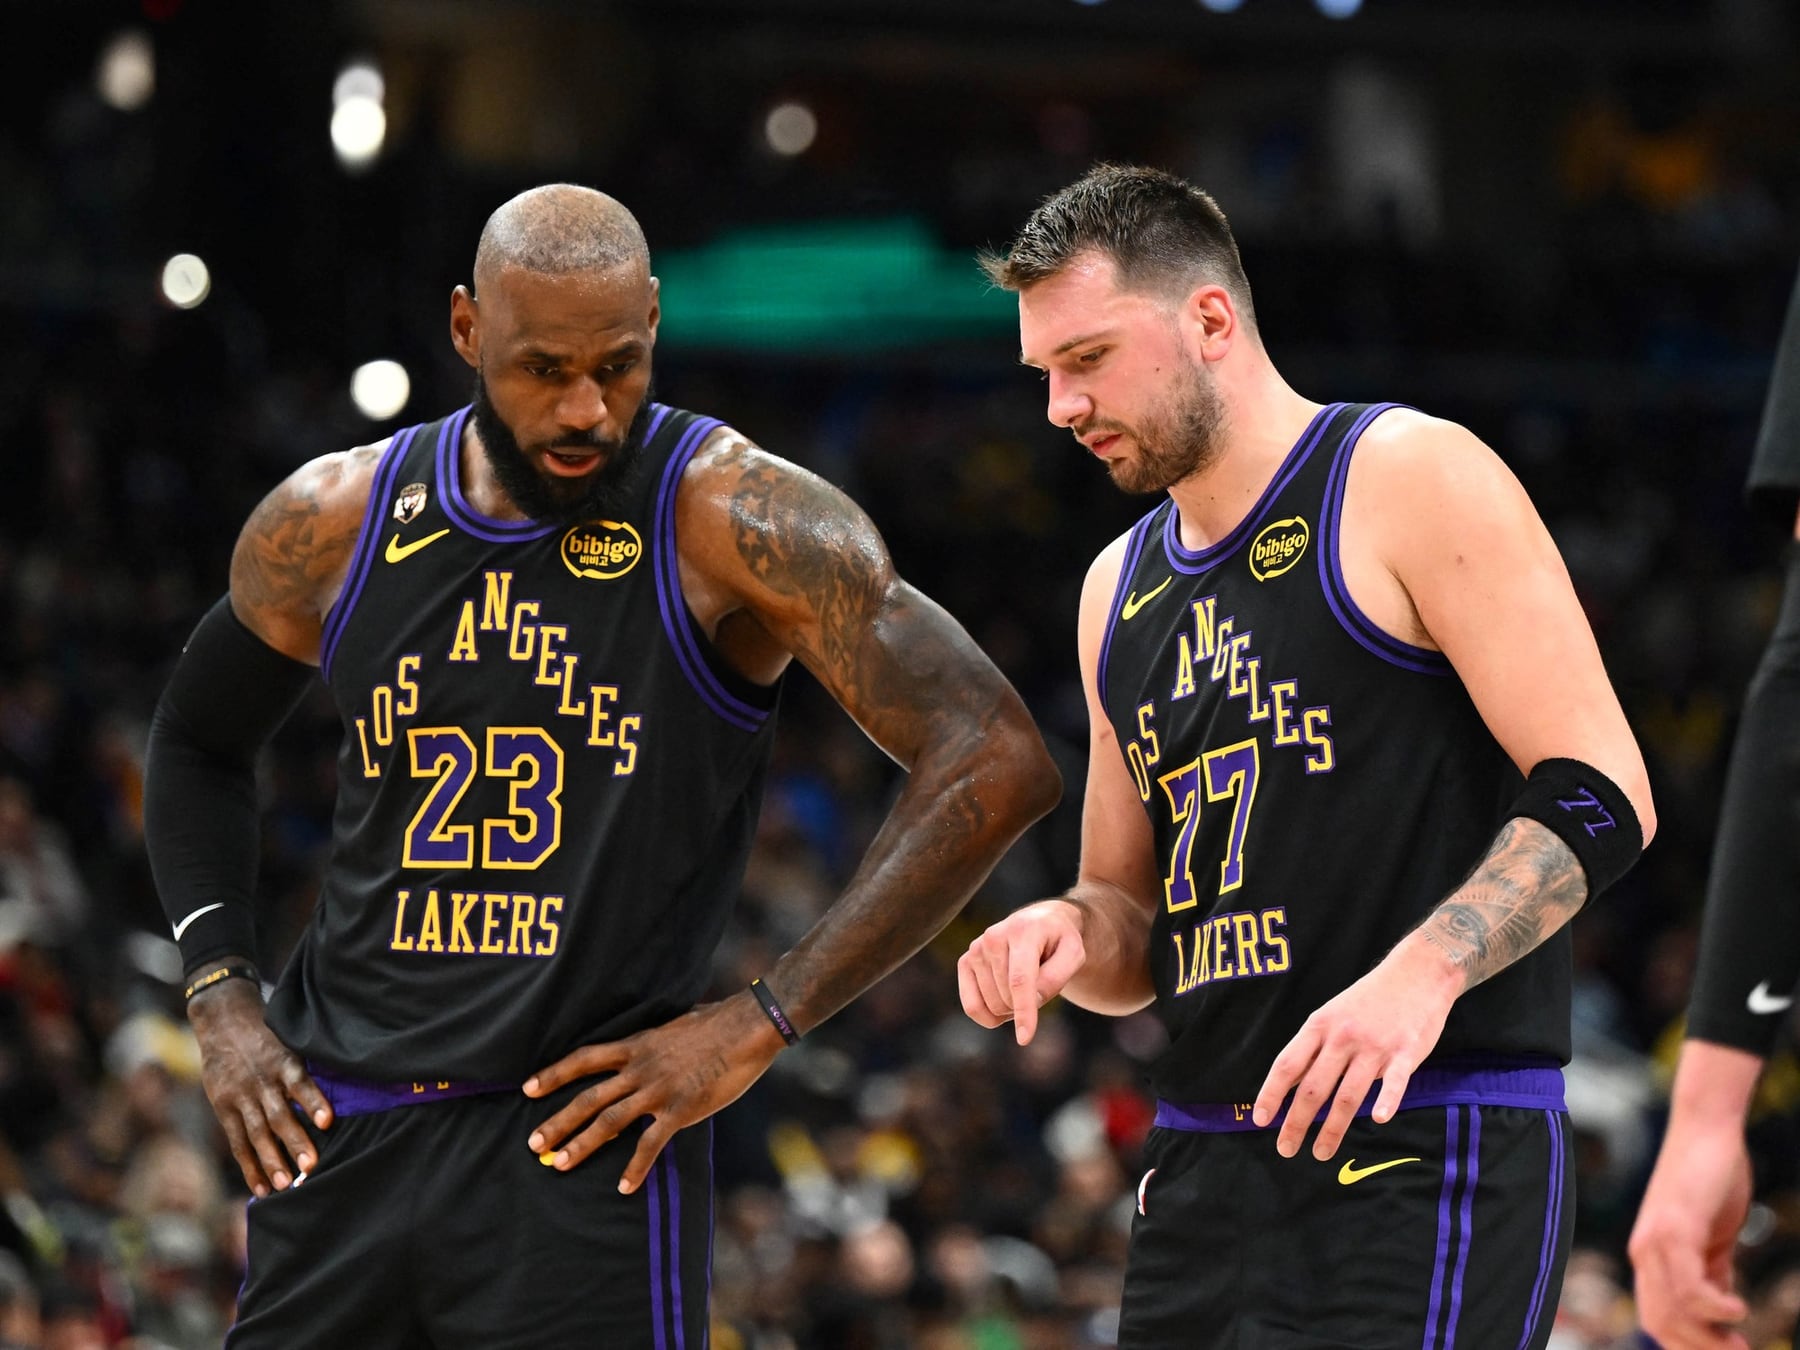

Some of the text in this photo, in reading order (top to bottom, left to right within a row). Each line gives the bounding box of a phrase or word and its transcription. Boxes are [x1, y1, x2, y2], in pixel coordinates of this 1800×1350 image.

[569, 534, 638, 564] bibigo
[579, 554, 609, 567] 비비고
[1255, 533, 1306, 561] bibigo
[354, 569, 644, 779] LOS ANGELES
[1126, 594, 1336, 805] OS ANGELES
[401, 726, 565, 870] 23
[1157, 736, 1261, 914] 77
[1556, 786, 1617, 838] 77
[389, 887, 565, 958] LAKERS
